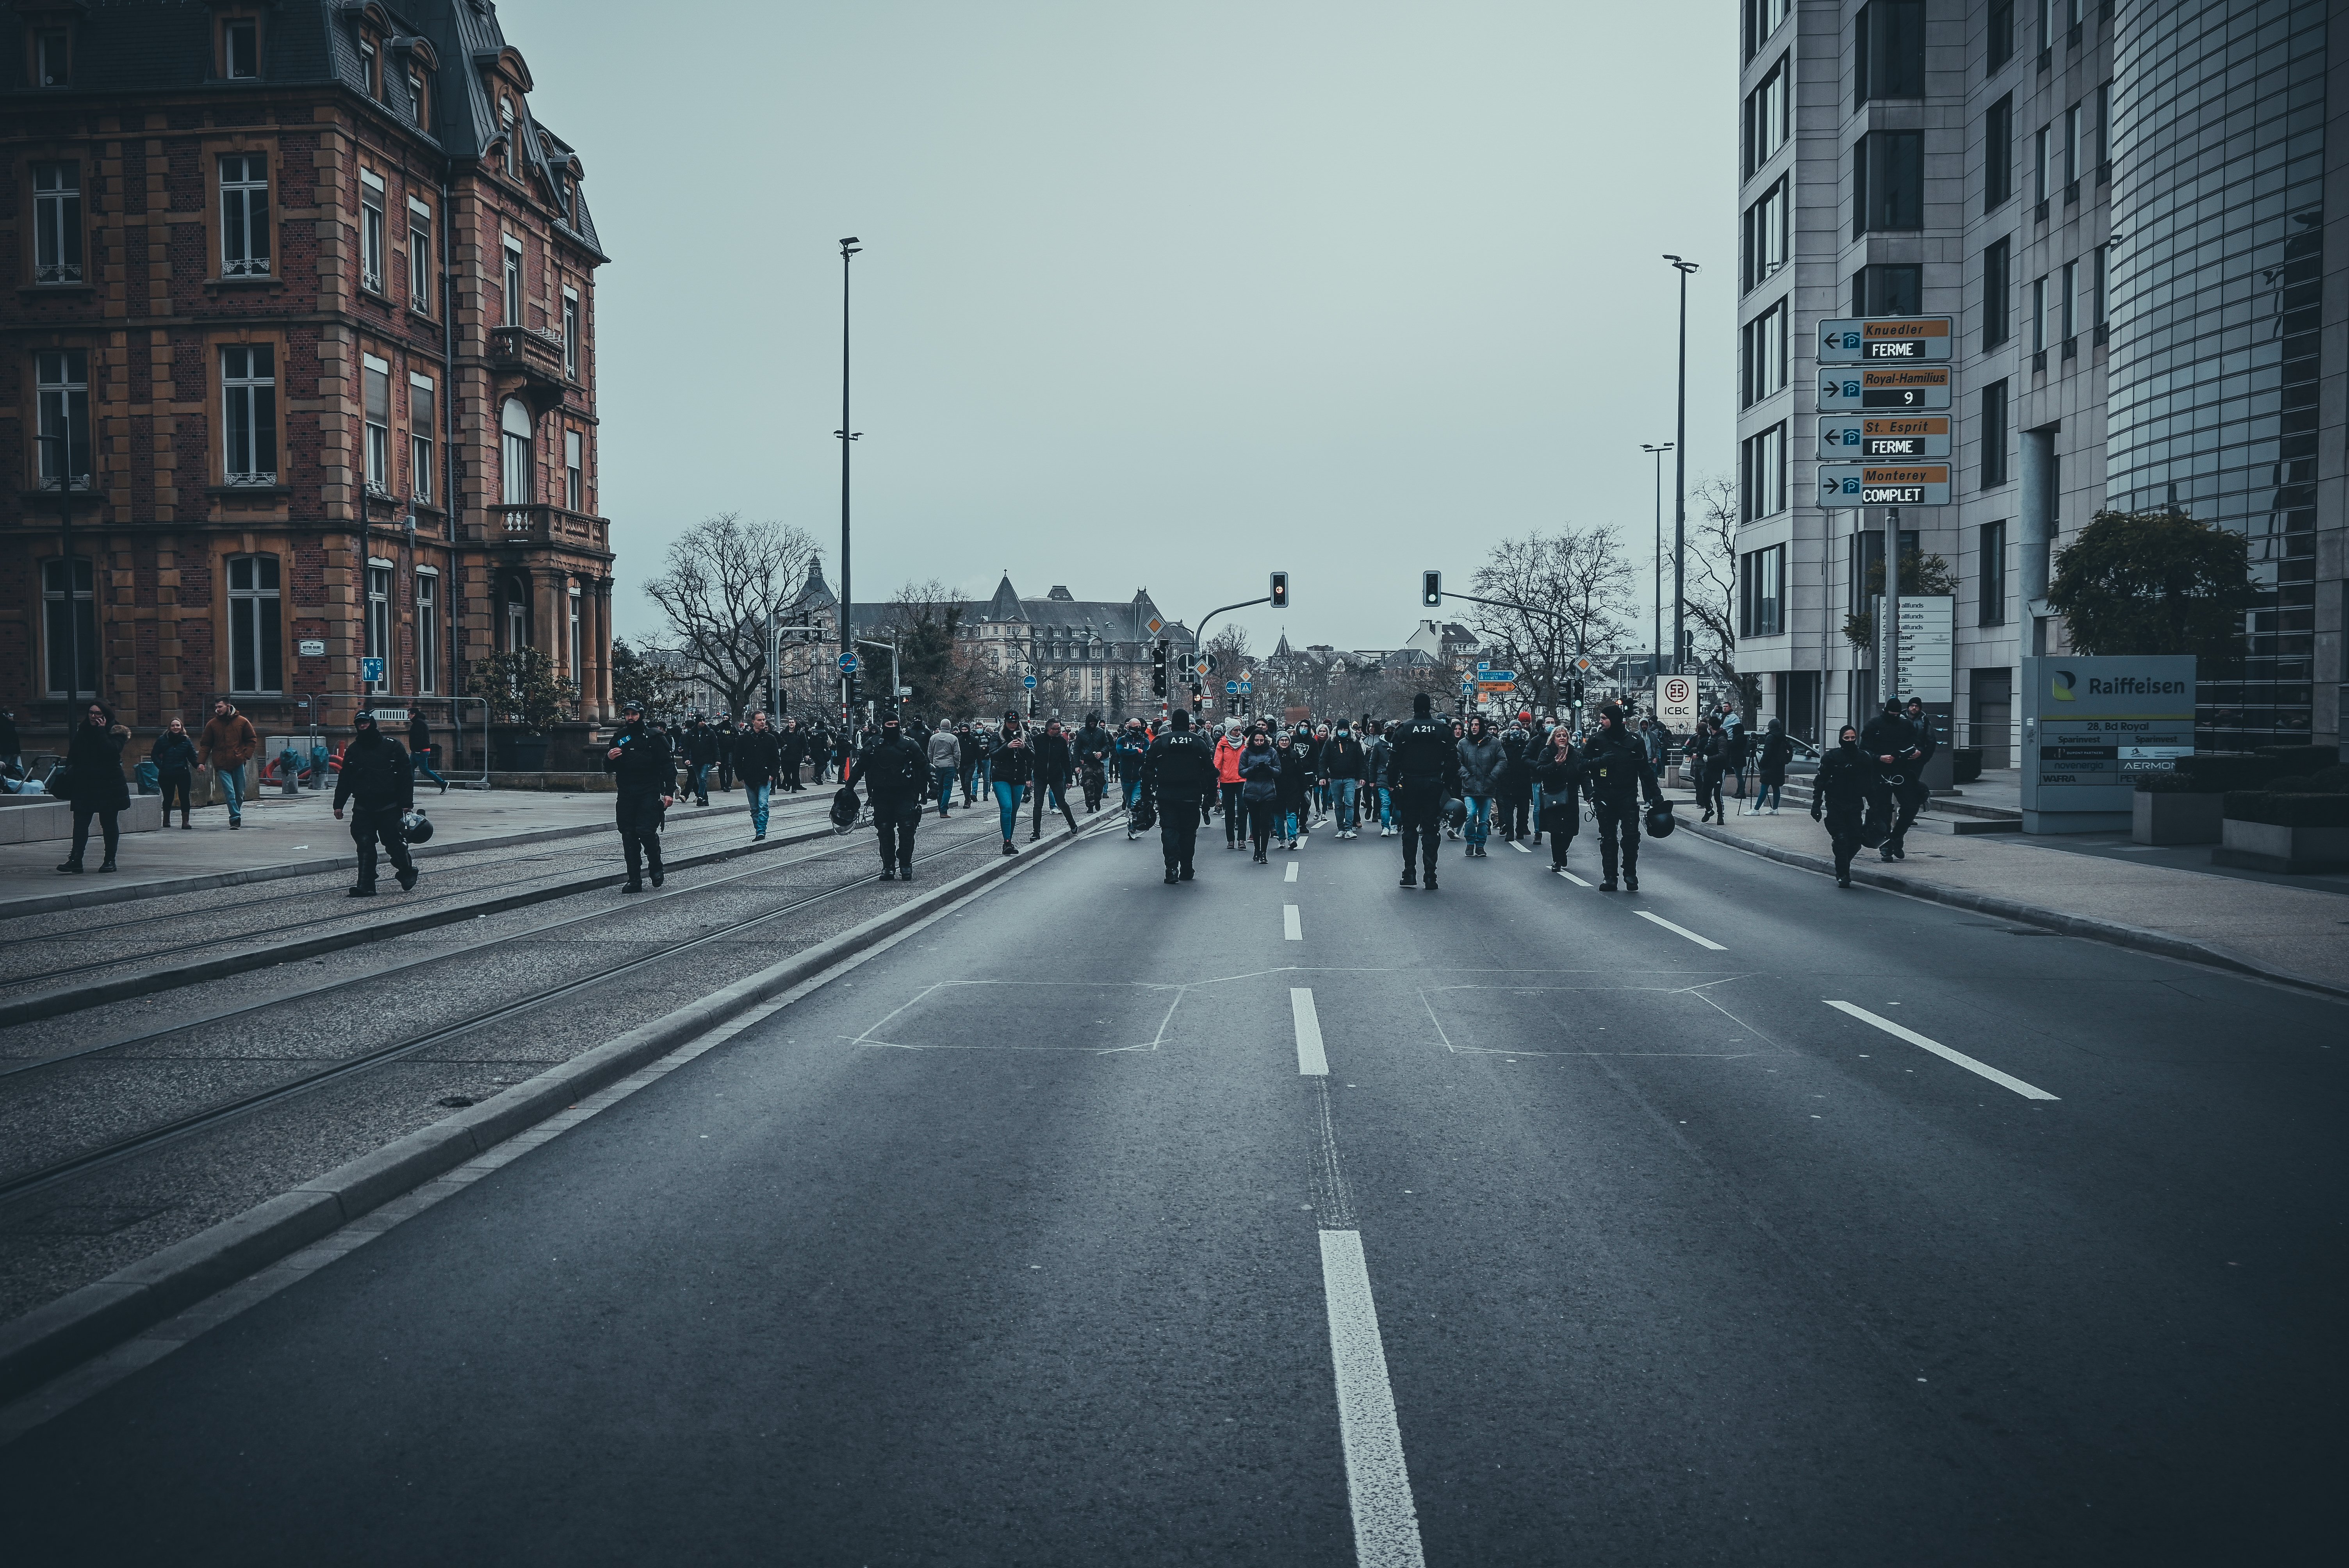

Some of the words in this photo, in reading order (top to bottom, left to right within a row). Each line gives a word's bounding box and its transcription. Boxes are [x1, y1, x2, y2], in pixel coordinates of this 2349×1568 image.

[1866, 324, 1923, 336] Knuedler
[1872, 343, 1914, 356] FERME
[1866, 372, 1945, 385] Royal-Hamilius
[1904, 392, 1913, 404] 9
[1866, 422, 1883, 433] St.
[1890, 421, 1928, 434] Esprit
[1872, 440, 1913, 454] FERME
[1865, 470, 1927, 483] Monterey
[1862, 488, 1921, 502] COMPLET
[2089, 677, 2185, 694] Raiffeisen
[1665, 707, 1689, 715] ICBC
[2087, 722, 2102, 732] 28,
[2105, 722, 2118, 731] Bd
[2121, 722, 2149, 732] Royal
[2058, 735, 2101, 745] Sparinvest
[2135, 735, 2177, 745] Sparinvest
[2055, 761, 2104, 771] novenergia
